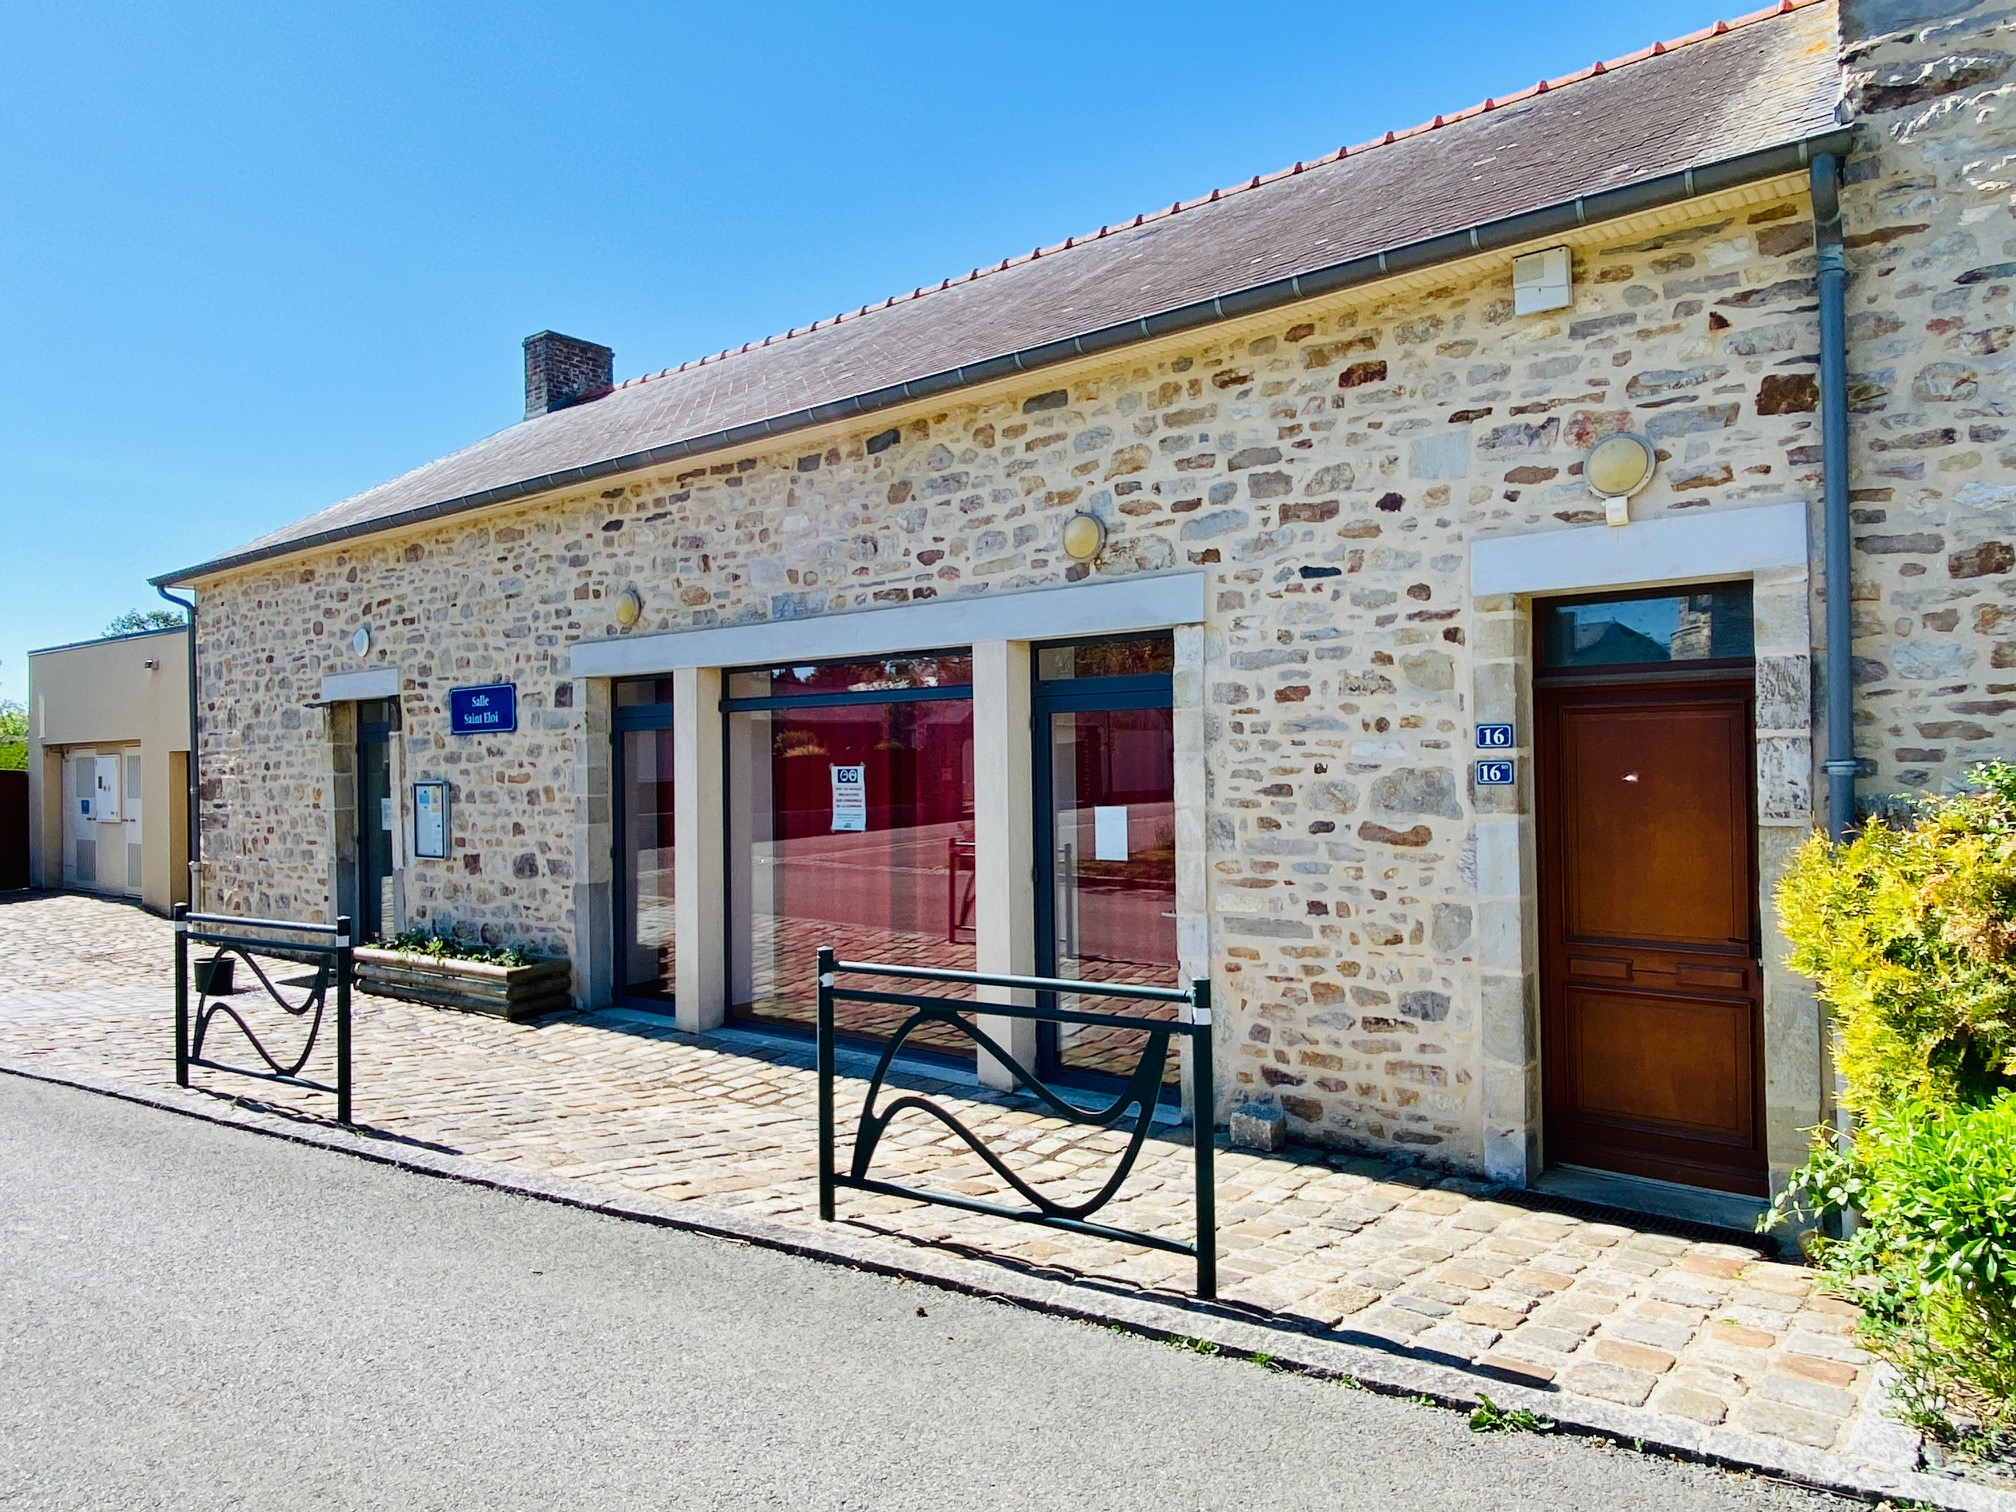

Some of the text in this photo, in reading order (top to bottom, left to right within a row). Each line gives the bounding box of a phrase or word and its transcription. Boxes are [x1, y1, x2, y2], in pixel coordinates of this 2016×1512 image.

[471, 695, 490, 707] Salle
[464, 713, 483, 725] Saint
[1483, 728, 1505, 745] 16
[1480, 764, 1501, 781] 16
